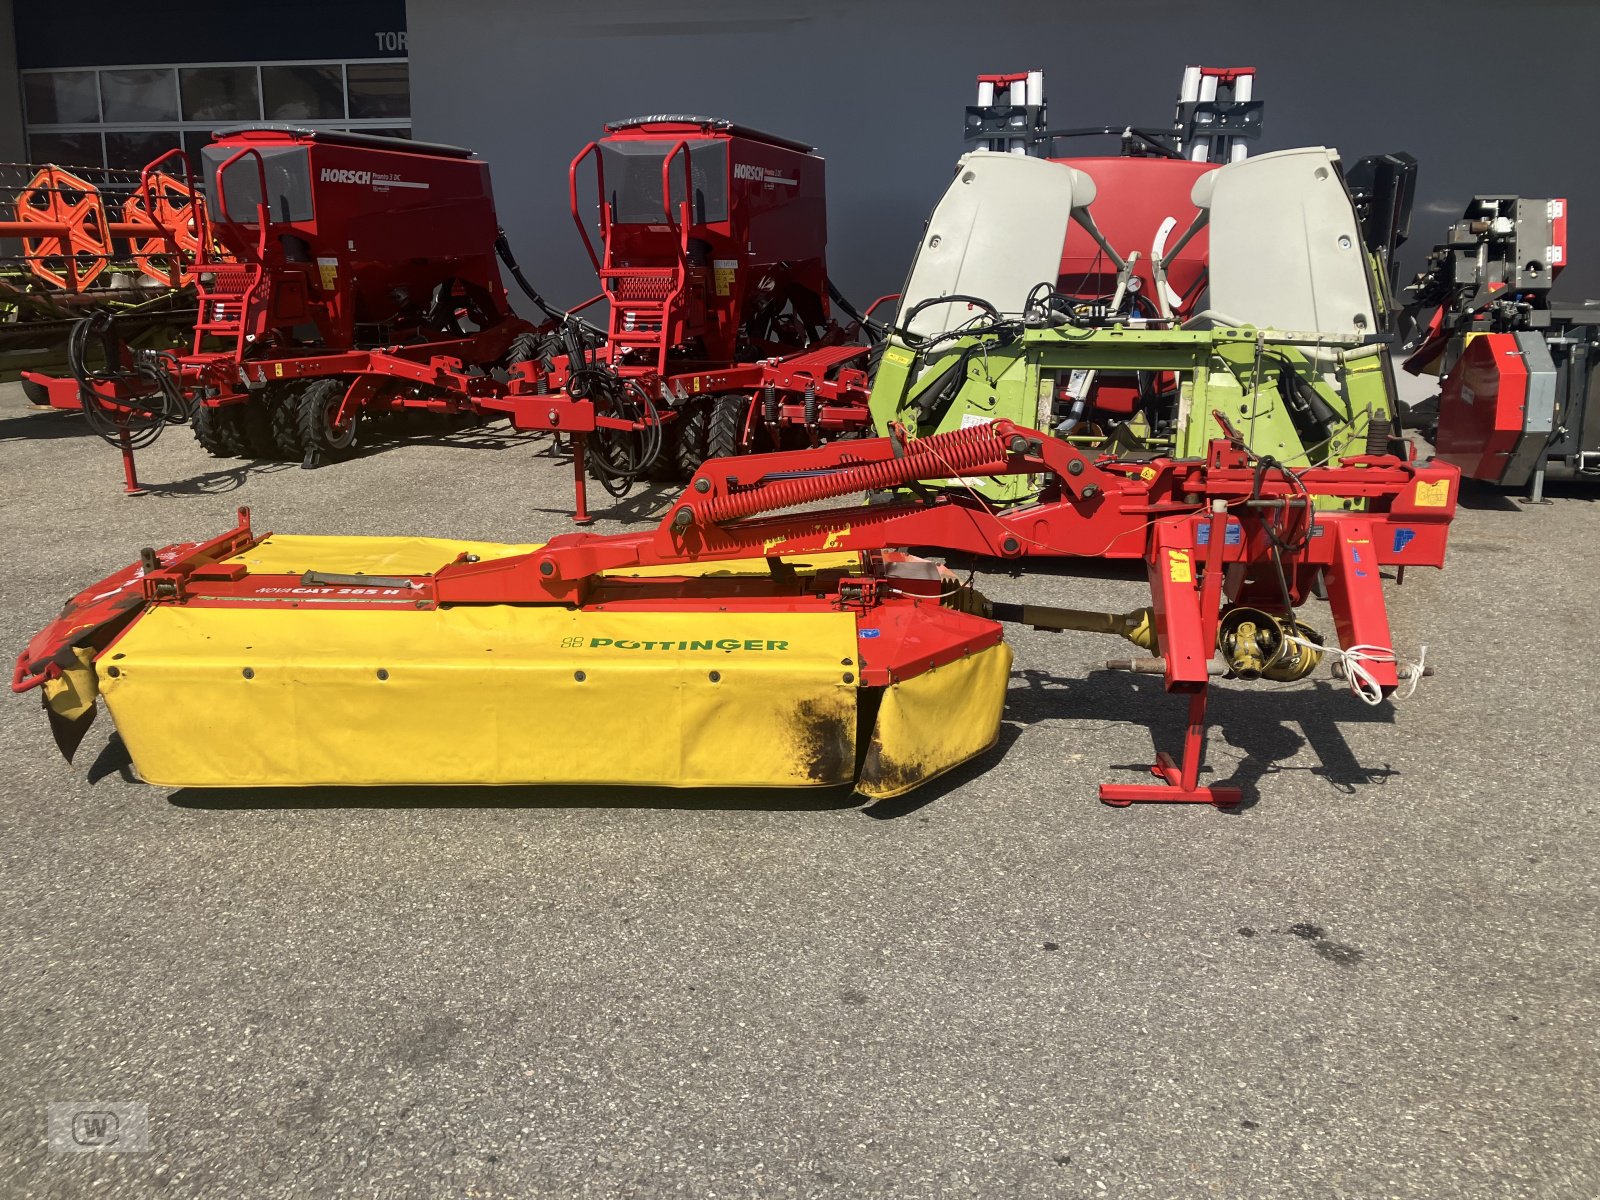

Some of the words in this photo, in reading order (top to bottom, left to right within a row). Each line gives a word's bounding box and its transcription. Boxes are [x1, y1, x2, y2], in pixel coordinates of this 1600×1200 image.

[374, 31, 408, 51] TOR
[320, 168, 371, 185] HORSCH
[734, 163, 764, 181] HORSCH
